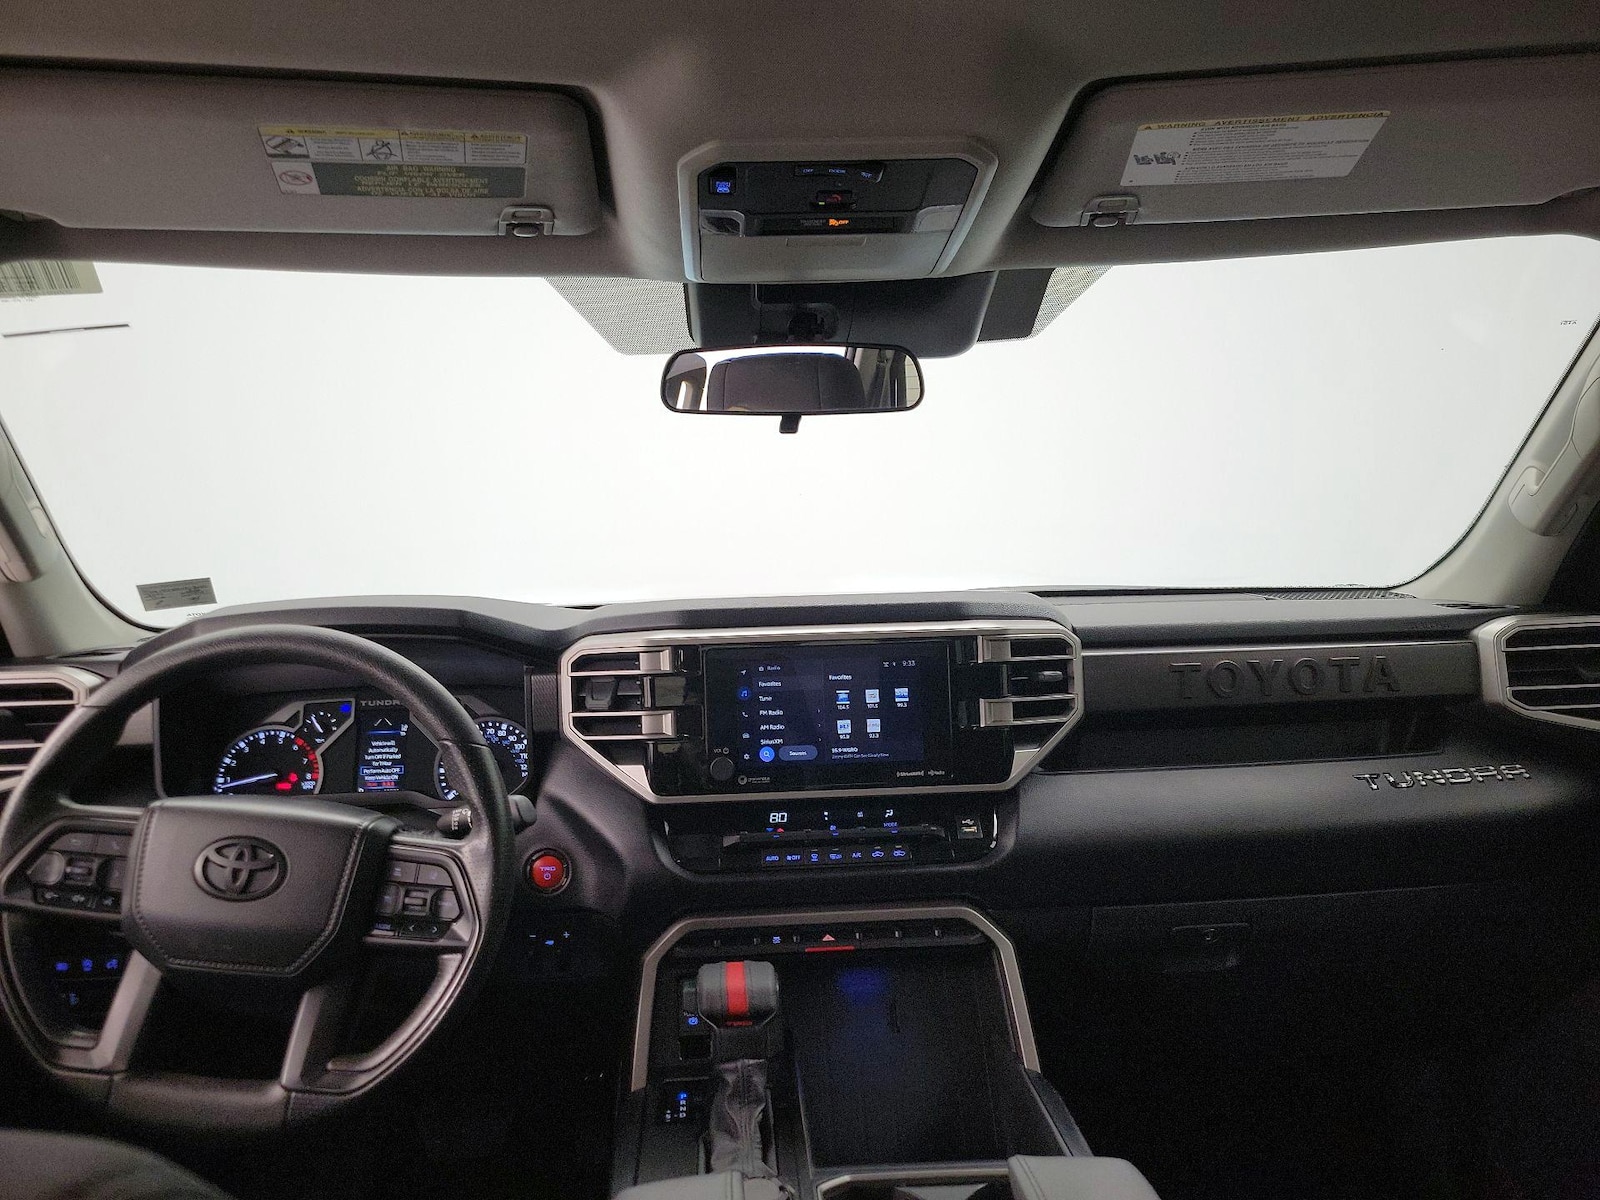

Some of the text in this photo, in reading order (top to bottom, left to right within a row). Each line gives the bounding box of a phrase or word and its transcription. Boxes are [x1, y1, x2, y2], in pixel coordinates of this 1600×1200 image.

[1215, 116, 1300, 126] AVERTISSEMENT
[1308, 112, 1384, 121] ADVERTENCIA
[1169, 656, 1400, 700] TOYOTA
[1352, 764, 1530, 790] TUNDRA
[769, 812, 787, 823] 80
